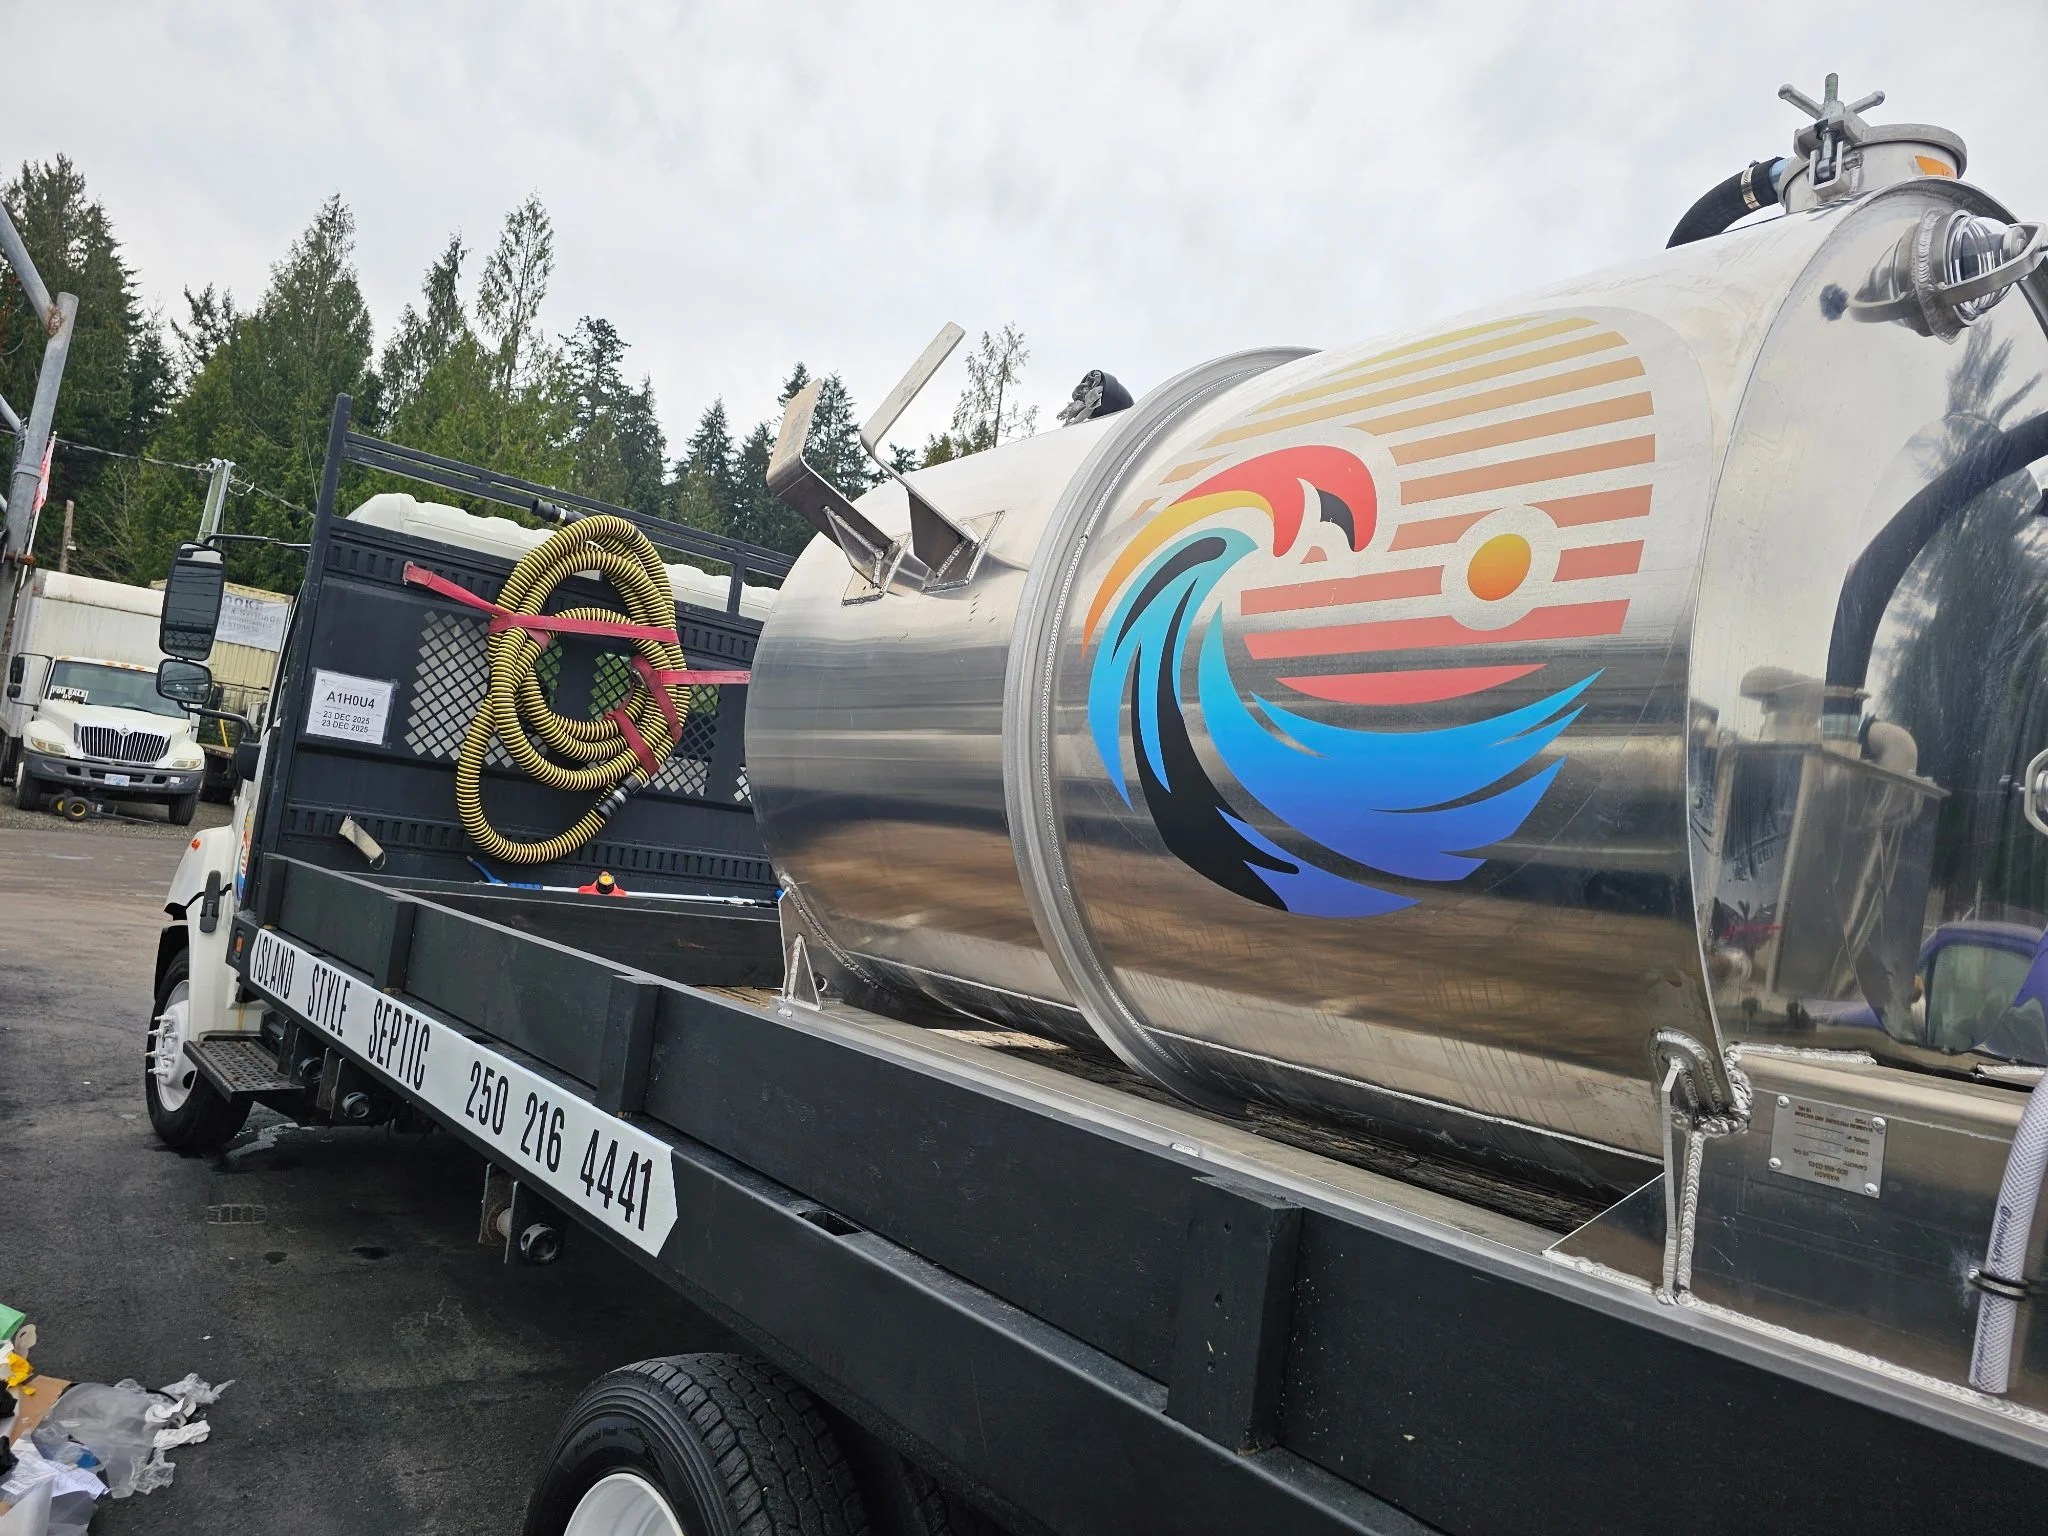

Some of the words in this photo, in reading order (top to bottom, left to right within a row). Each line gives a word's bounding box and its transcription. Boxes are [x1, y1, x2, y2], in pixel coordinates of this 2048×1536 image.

[323, 711, 333, 719] 23
[334, 712, 351, 721] DEC
[352, 715, 370, 725] 2025
[321, 719, 331, 727] 23
[332, 721, 350, 730] DEC
[351, 724, 369, 733] 2025
[253, 933, 295, 1000] ISLAND
[307, 963, 351, 1038] STYLE
[368, 998, 431, 1091] SEPTIC
[465, 1060, 509, 1136] 250
[520, 1091, 565, 1173] 216
[580, 1128, 653, 1232] 4441
